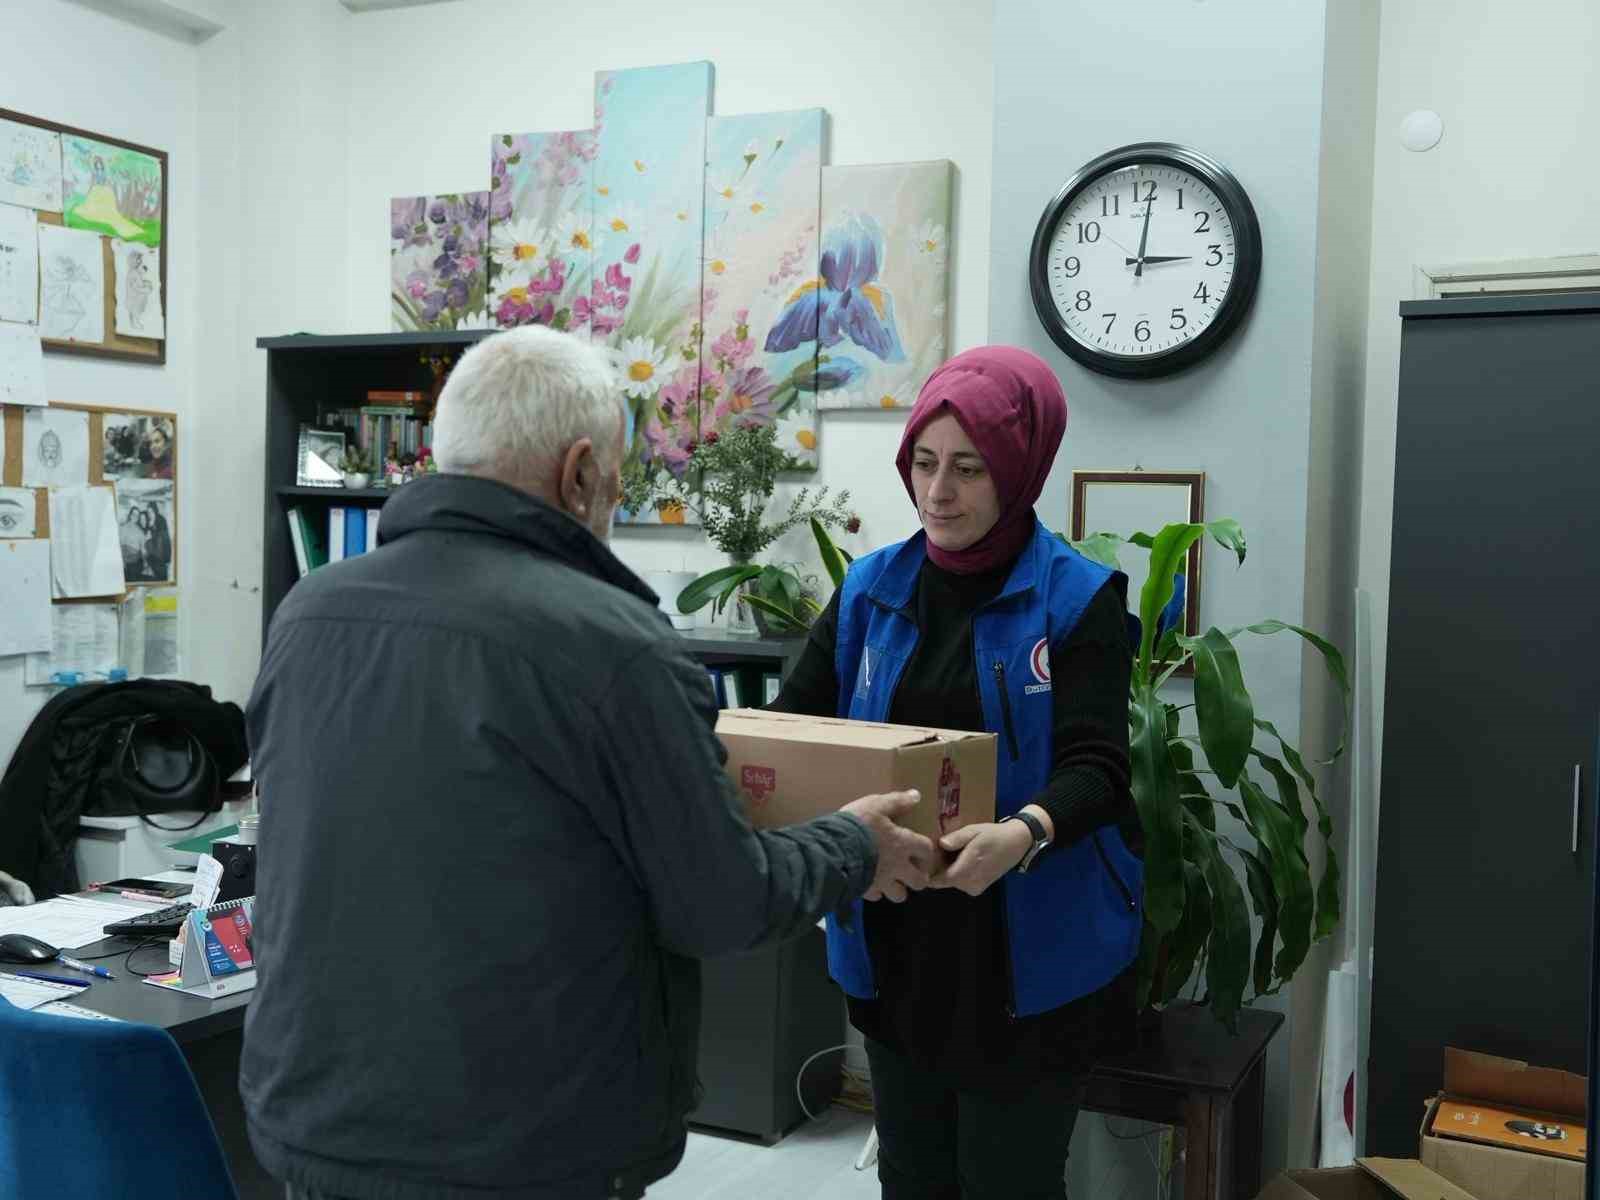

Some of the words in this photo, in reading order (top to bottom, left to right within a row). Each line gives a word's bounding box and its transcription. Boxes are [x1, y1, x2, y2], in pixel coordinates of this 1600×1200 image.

[1131, 180, 1158, 203] 12
[1176, 188, 1184, 210] 1
[1101, 194, 1120, 217] 11
[1077, 221, 1101, 244] 10
[1194, 211, 1210, 233] 2
[1205, 244, 1223, 267] 3
[1065, 256, 1081, 278] 9
[1075, 290, 1092, 312] 8
[1193, 281, 1211, 304] 4
[1102, 313, 1117, 334] 7
[1169, 308, 1187, 330] 5
[1134, 320, 1151, 342] 6
